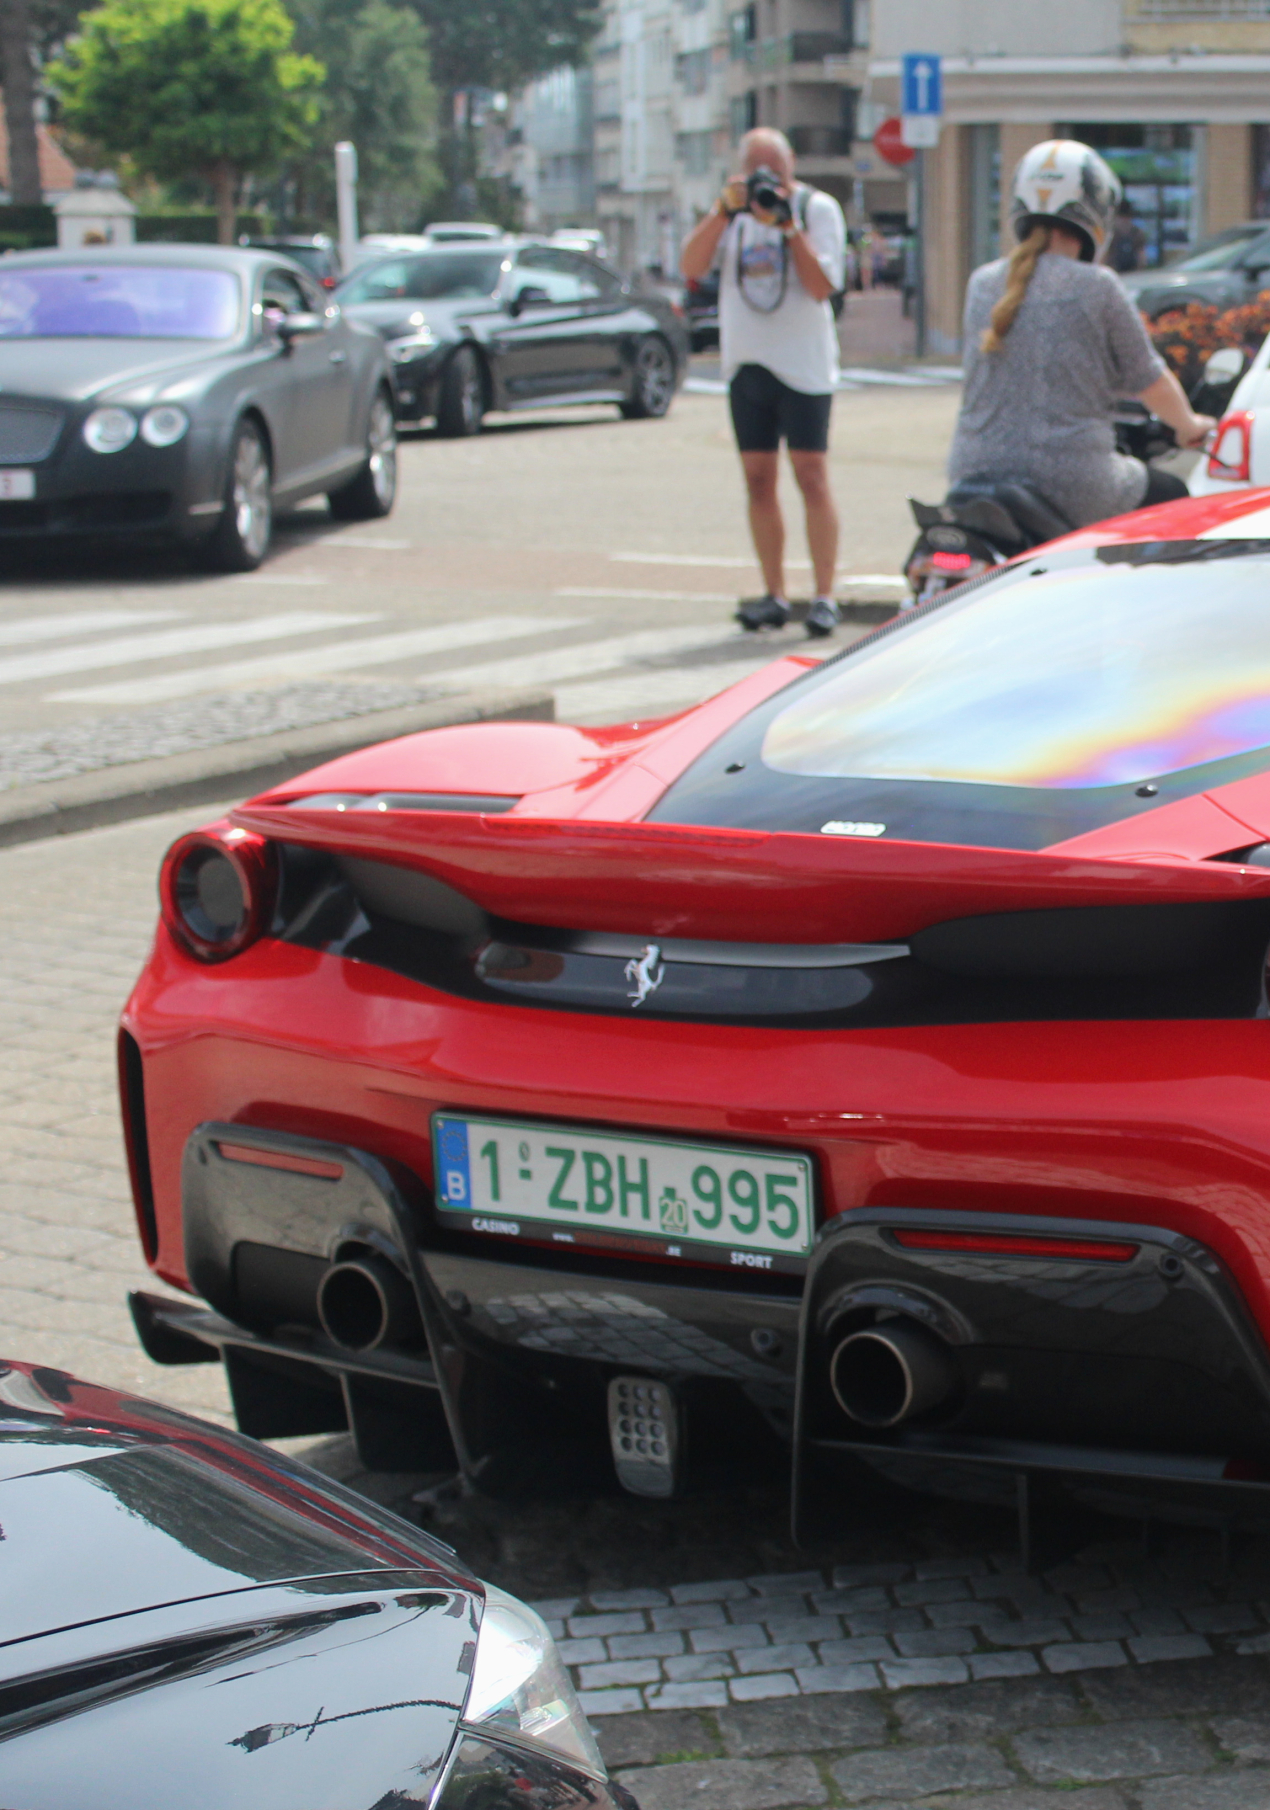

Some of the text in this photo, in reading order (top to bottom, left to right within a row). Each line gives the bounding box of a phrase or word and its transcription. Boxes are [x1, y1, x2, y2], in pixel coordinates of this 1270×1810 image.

[447, 1171, 466, 1200] B
[661, 1199, 687, 1228] 20
[472, 1217, 520, 1236] CASINO
[730, 1251, 773, 1270] SPORT
